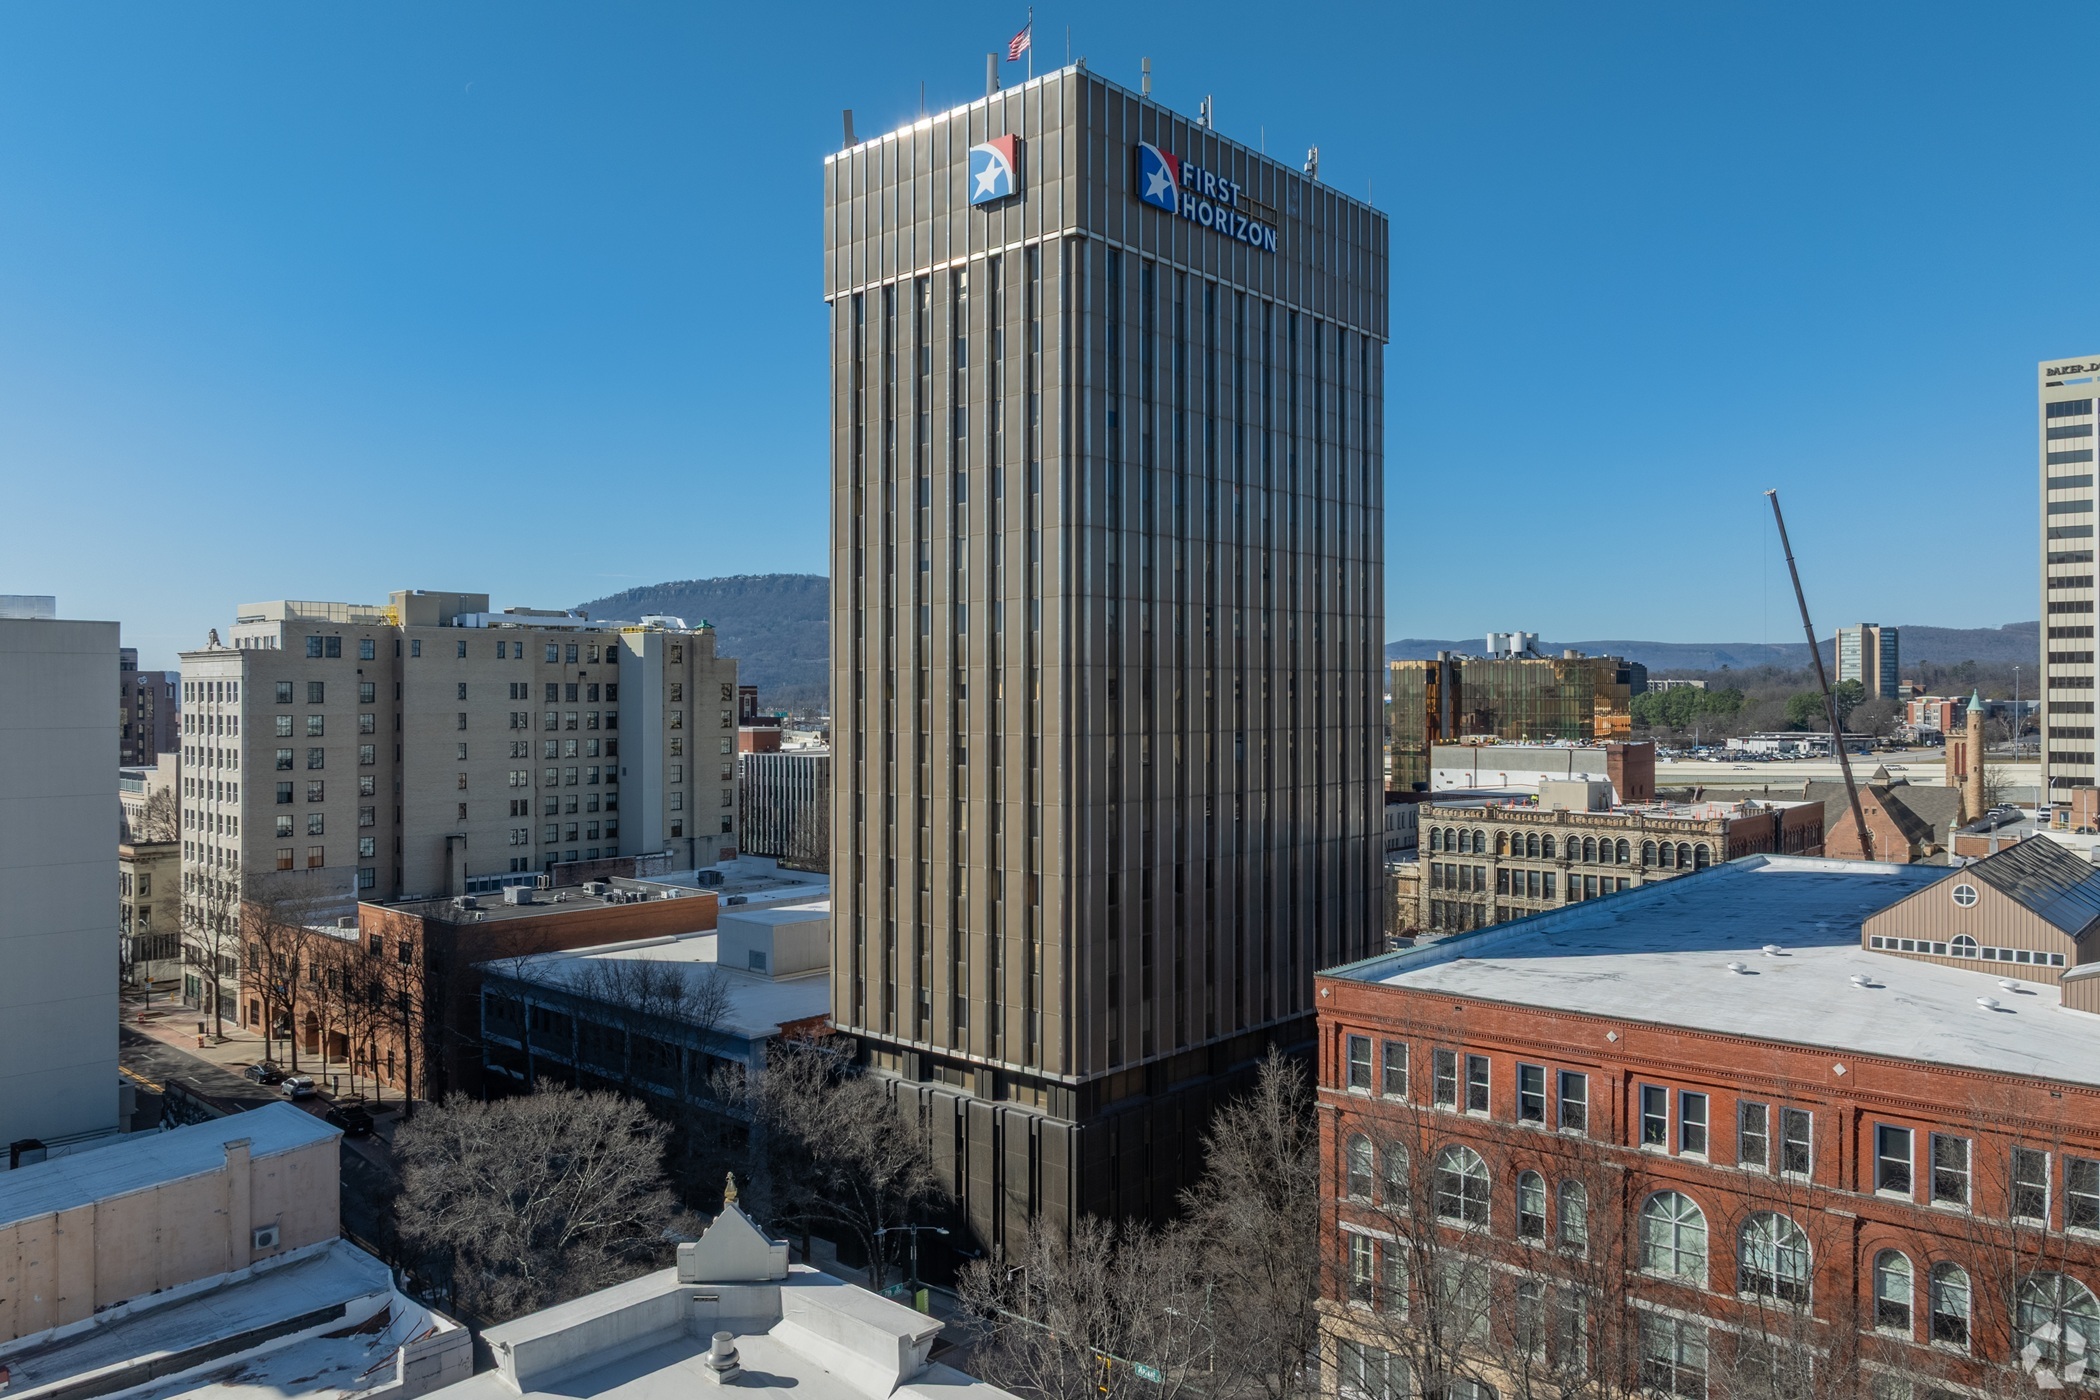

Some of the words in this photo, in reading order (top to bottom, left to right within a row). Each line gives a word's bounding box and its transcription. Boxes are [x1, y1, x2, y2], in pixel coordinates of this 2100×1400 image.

[1183, 161, 1240, 207] FIRST
[1183, 194, 1276, 252] HORIZON
[2046, 364, 2086, 376] BAKER
